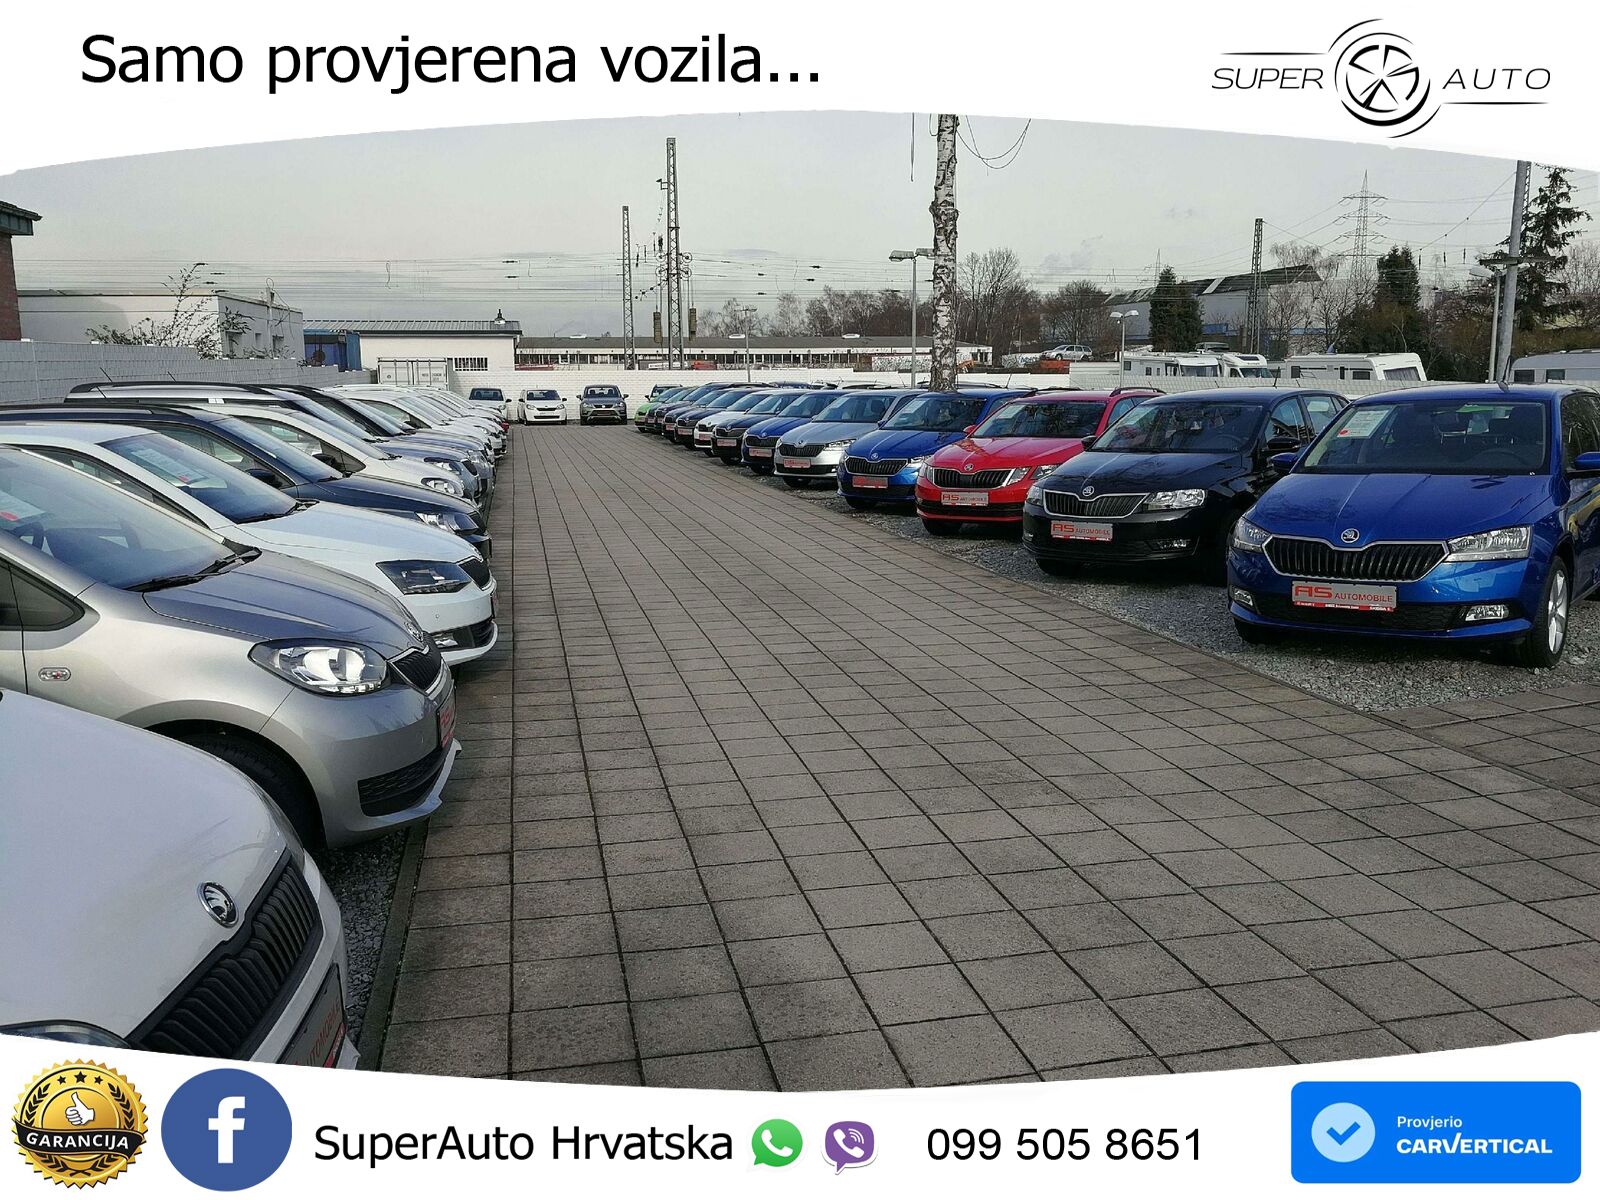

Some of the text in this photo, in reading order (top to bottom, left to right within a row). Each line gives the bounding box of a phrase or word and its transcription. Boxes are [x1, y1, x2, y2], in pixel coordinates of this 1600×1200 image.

[1052, 523, 1075, 533] AS
[1294, 585, 1393, 603] AS AUTOMOBILE
